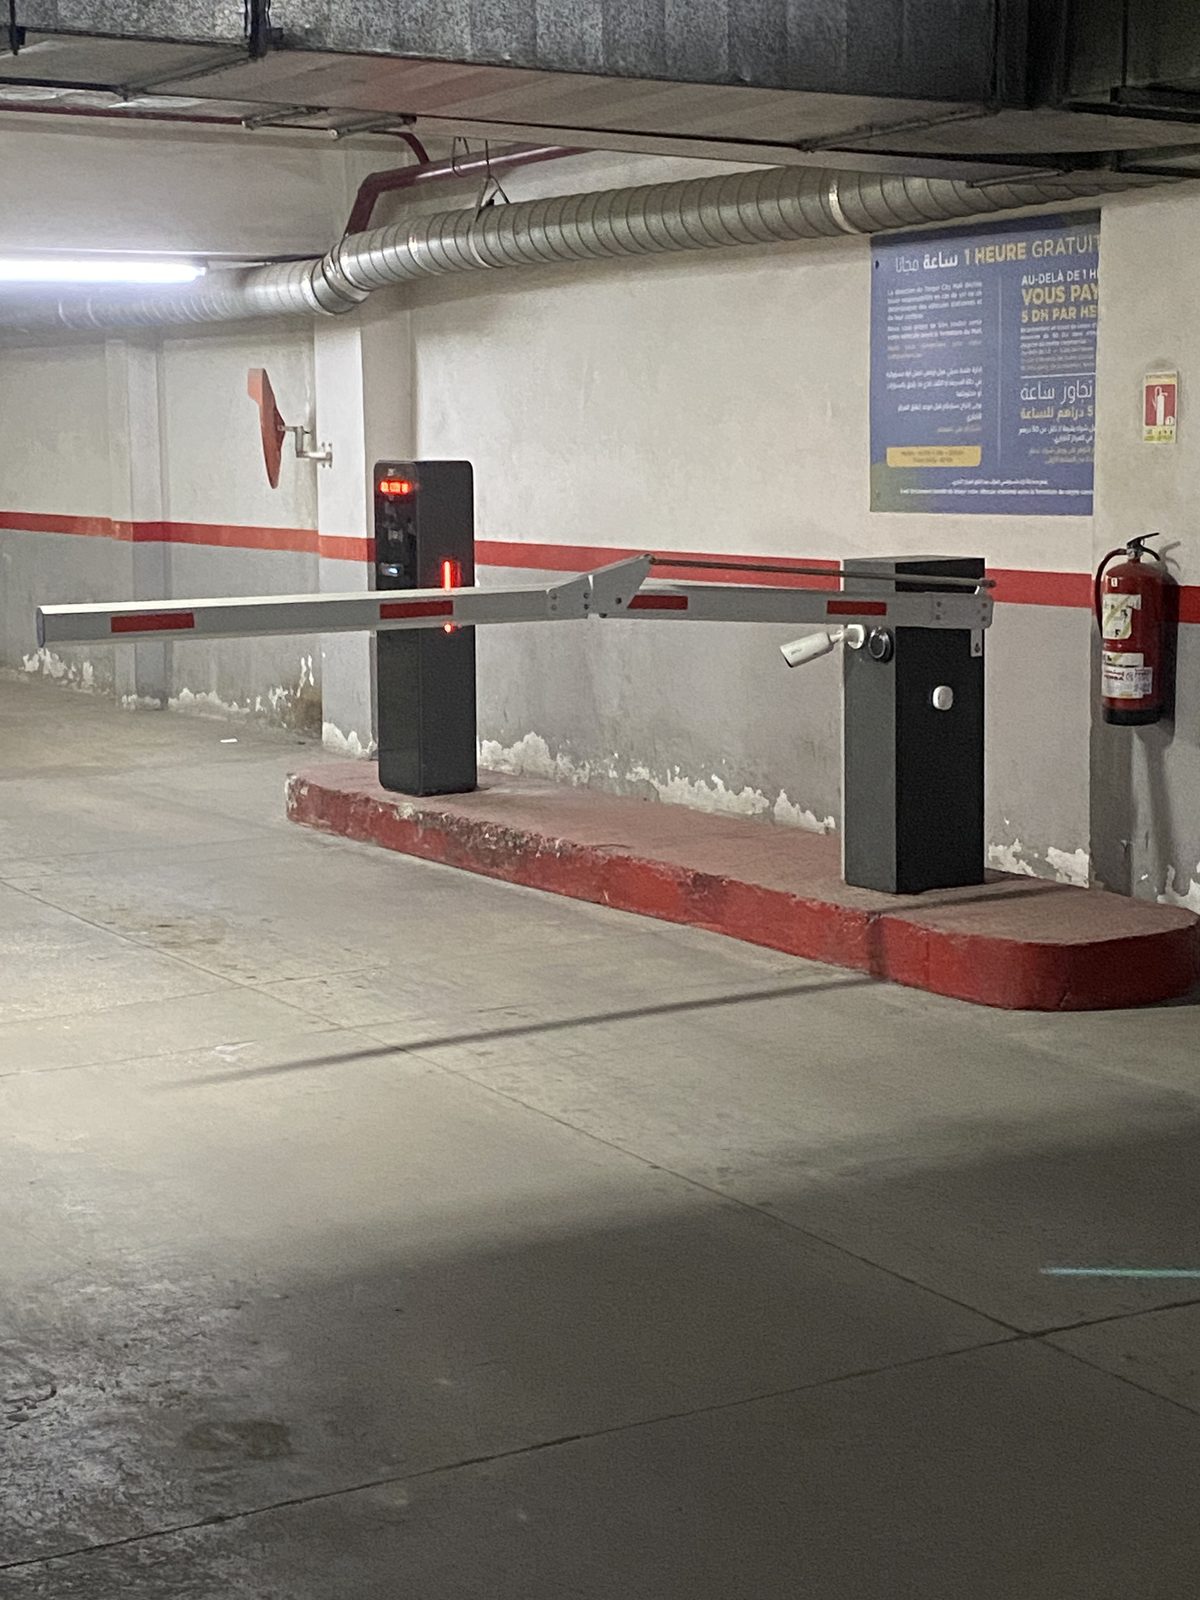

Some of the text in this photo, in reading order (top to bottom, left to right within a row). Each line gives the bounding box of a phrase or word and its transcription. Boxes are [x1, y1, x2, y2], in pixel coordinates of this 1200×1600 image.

[923, 251, 958, 270] ساعة
[964, 247, 971, 266] 1
[975, 241, 1027, 266] HEURE
[1066, 269, 1081, 283] DE
[1021, 285, 1066, 306] VOUS
[1021, 310, 1029, 324] 5
[1031, 308, 1049, 323] DH
[1052, 306, 1077, 321] PAR
